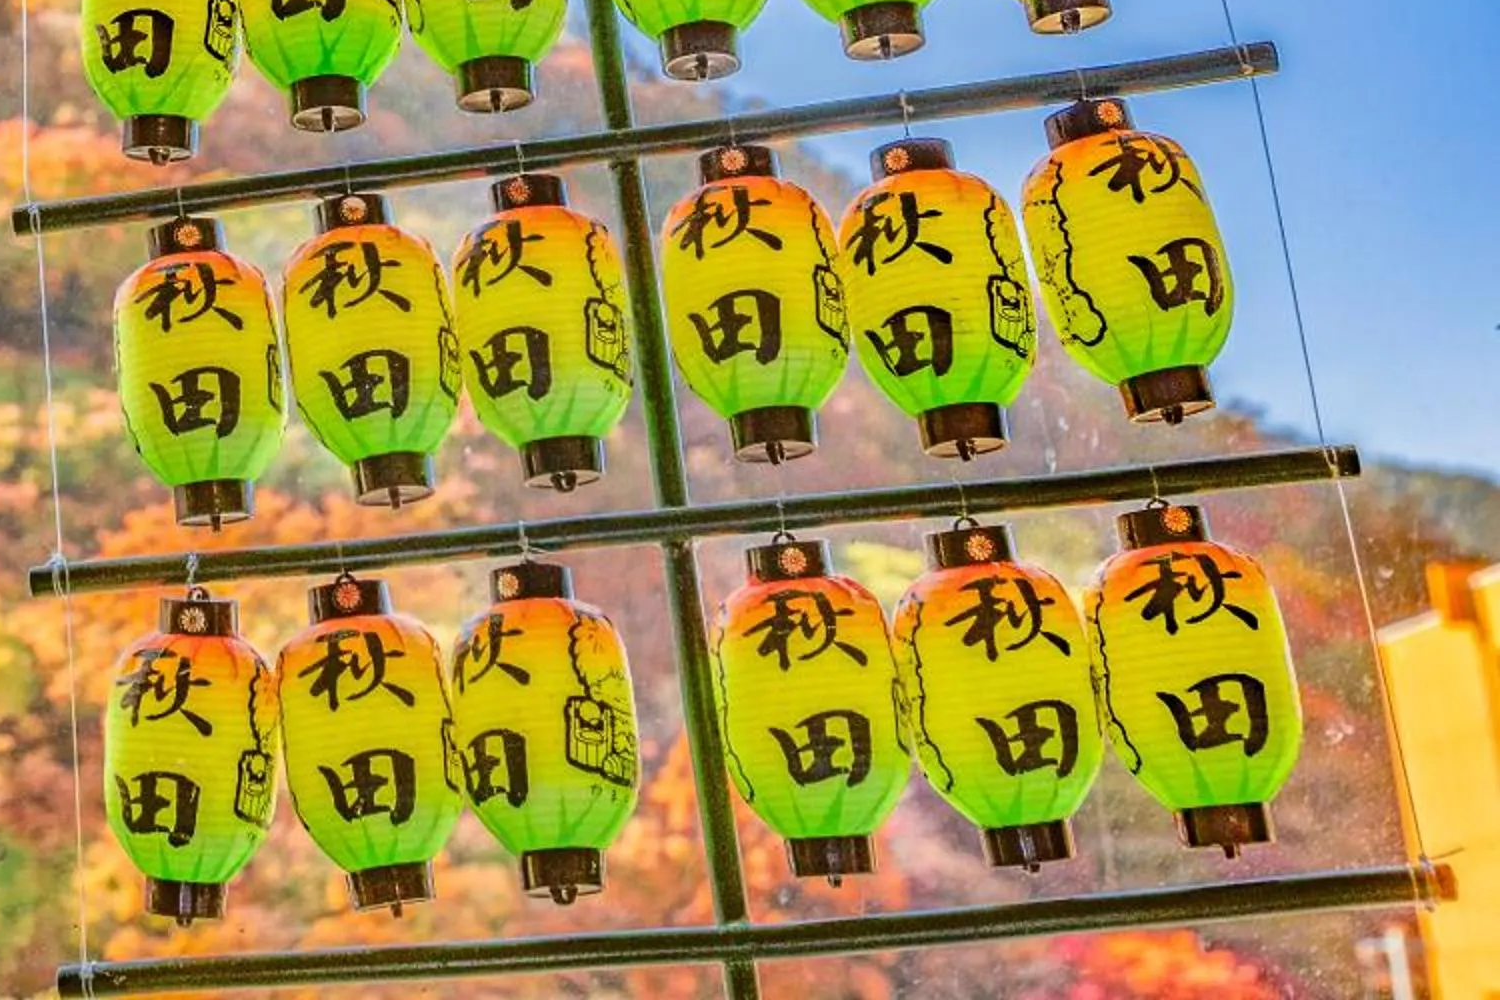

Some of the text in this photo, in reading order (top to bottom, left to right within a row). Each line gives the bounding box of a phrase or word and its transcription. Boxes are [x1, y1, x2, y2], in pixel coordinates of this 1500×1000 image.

[457, 220, 553, 401] 秋田
[670, 187, 784, 366] 秋田
[845, 191, 954, 377] 秋田
[1089, 135, 1224, 317] 秋田
[136, 263, 244, 439] 秋田
[299, 241, 412, 421] 秋田
[115, 647, 213, 849] 秋田
[299, 628, 417, 826] 秋田
[742, 589, 873, 788] 秋田
[944, 575, 1079, 779] 秋田
[1124, 552, 1269, 758] 秋田
